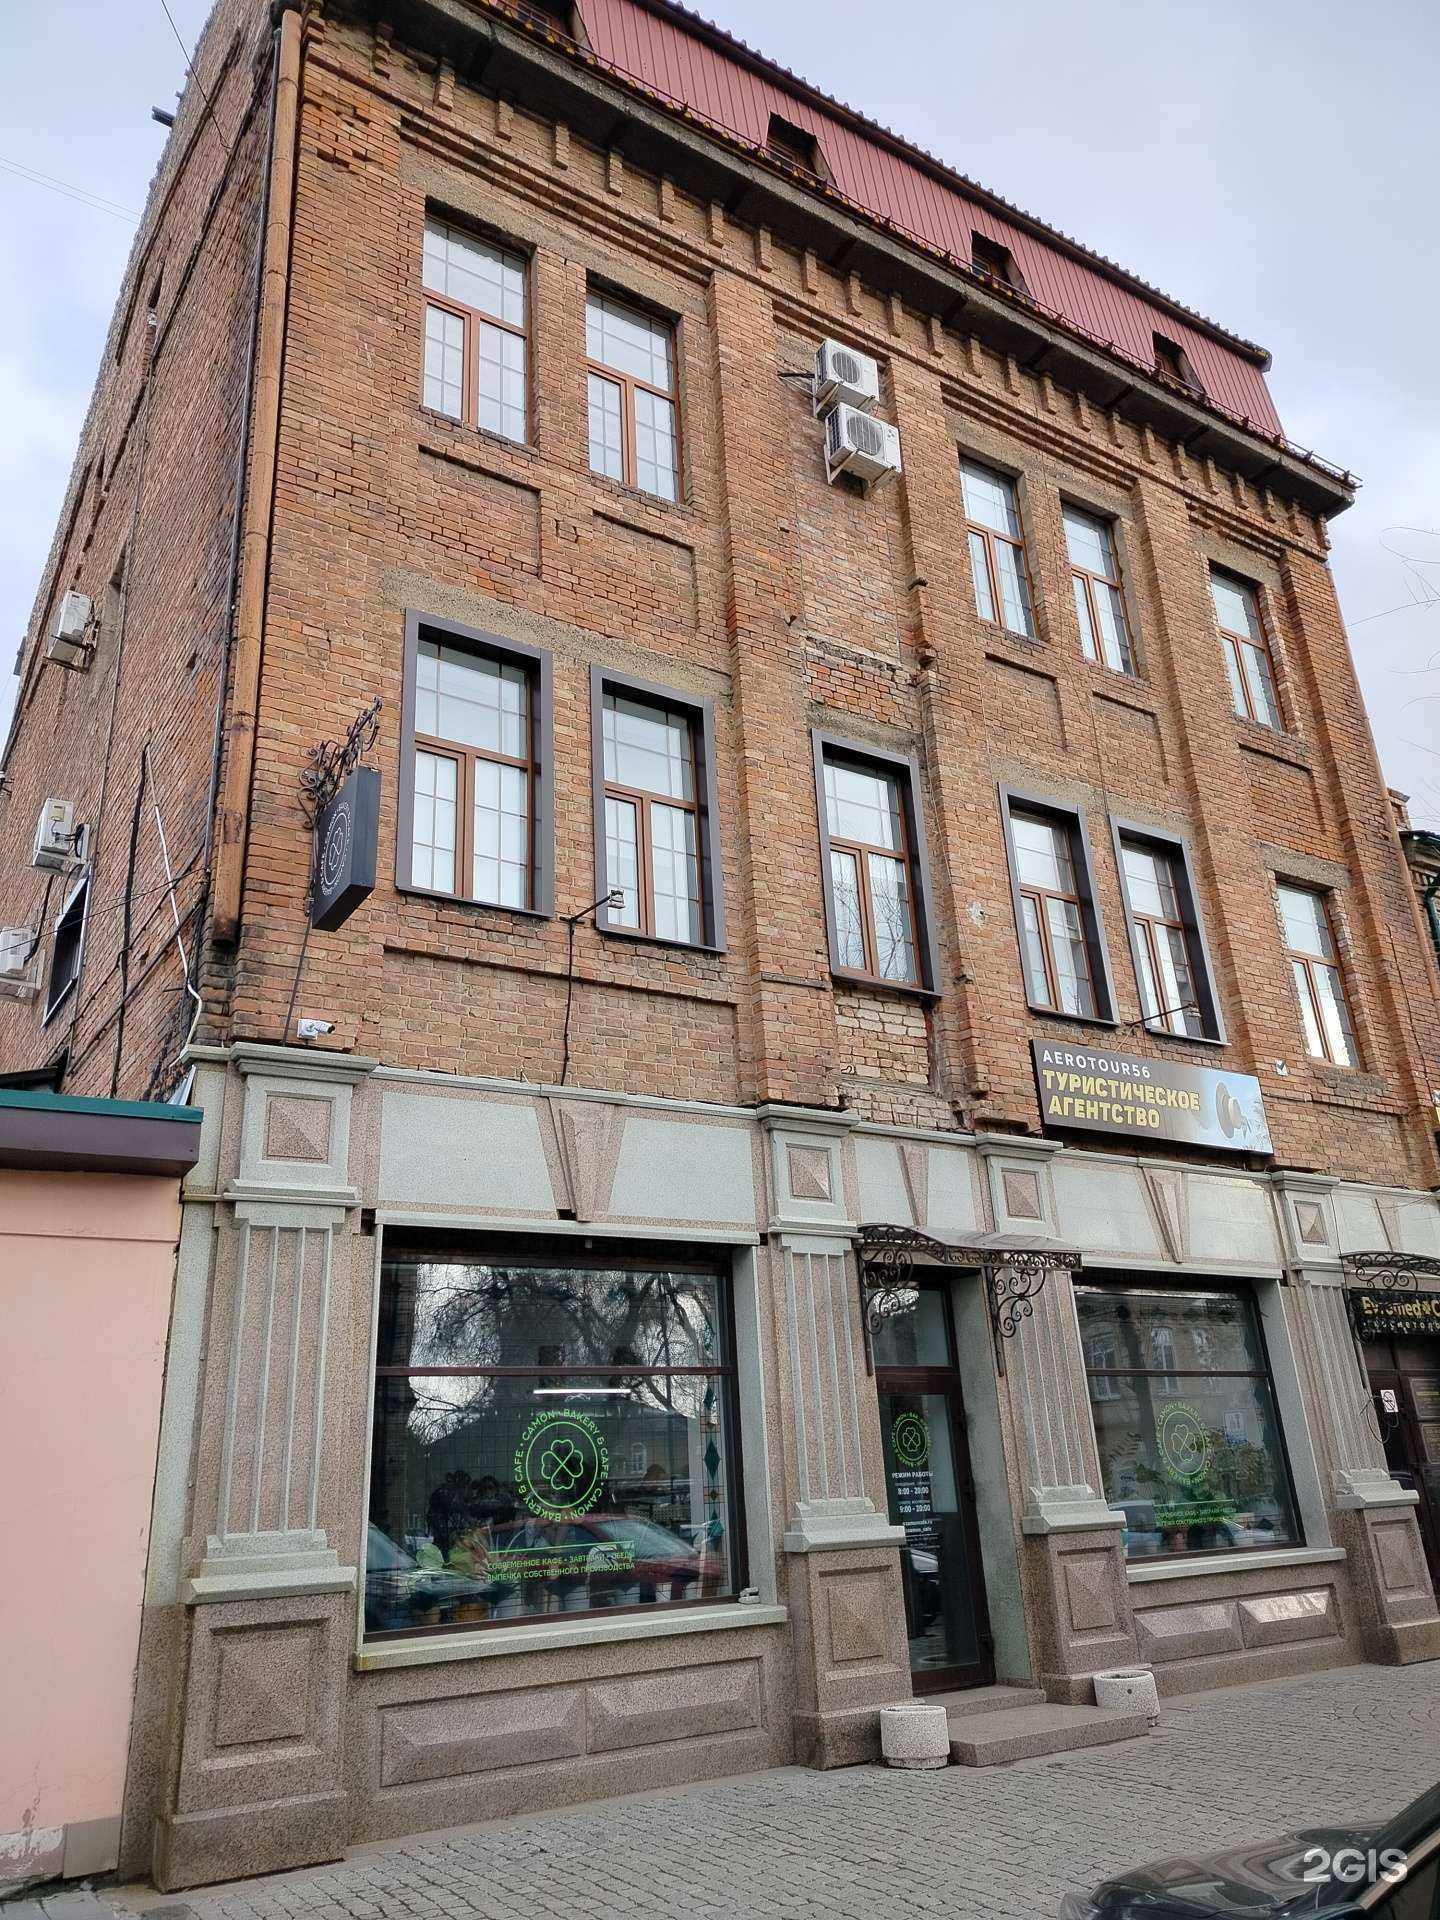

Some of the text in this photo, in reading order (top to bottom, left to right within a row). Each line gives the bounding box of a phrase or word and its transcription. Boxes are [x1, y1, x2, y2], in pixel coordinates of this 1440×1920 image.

[1043, 1050, 1150, 1079] AEROTOUR56
[1042, 1069, 1200, 1111] ТУРИСТИЧЕСКОЕ
[1048, 1095, 1160, 1129] АГЕНТСТВО
[522, 1410, 558, 1441] CAMON
[564, 1409, 600, 1435] BAKERY
[600, 1448, 609, 1479] CAFE
[514, 1450, 524, 1482] CAFE
[523, 1567, 579, 1578] СОБСТВЕННОГО
[542, 1557, 563, 1565] КАФЕ
